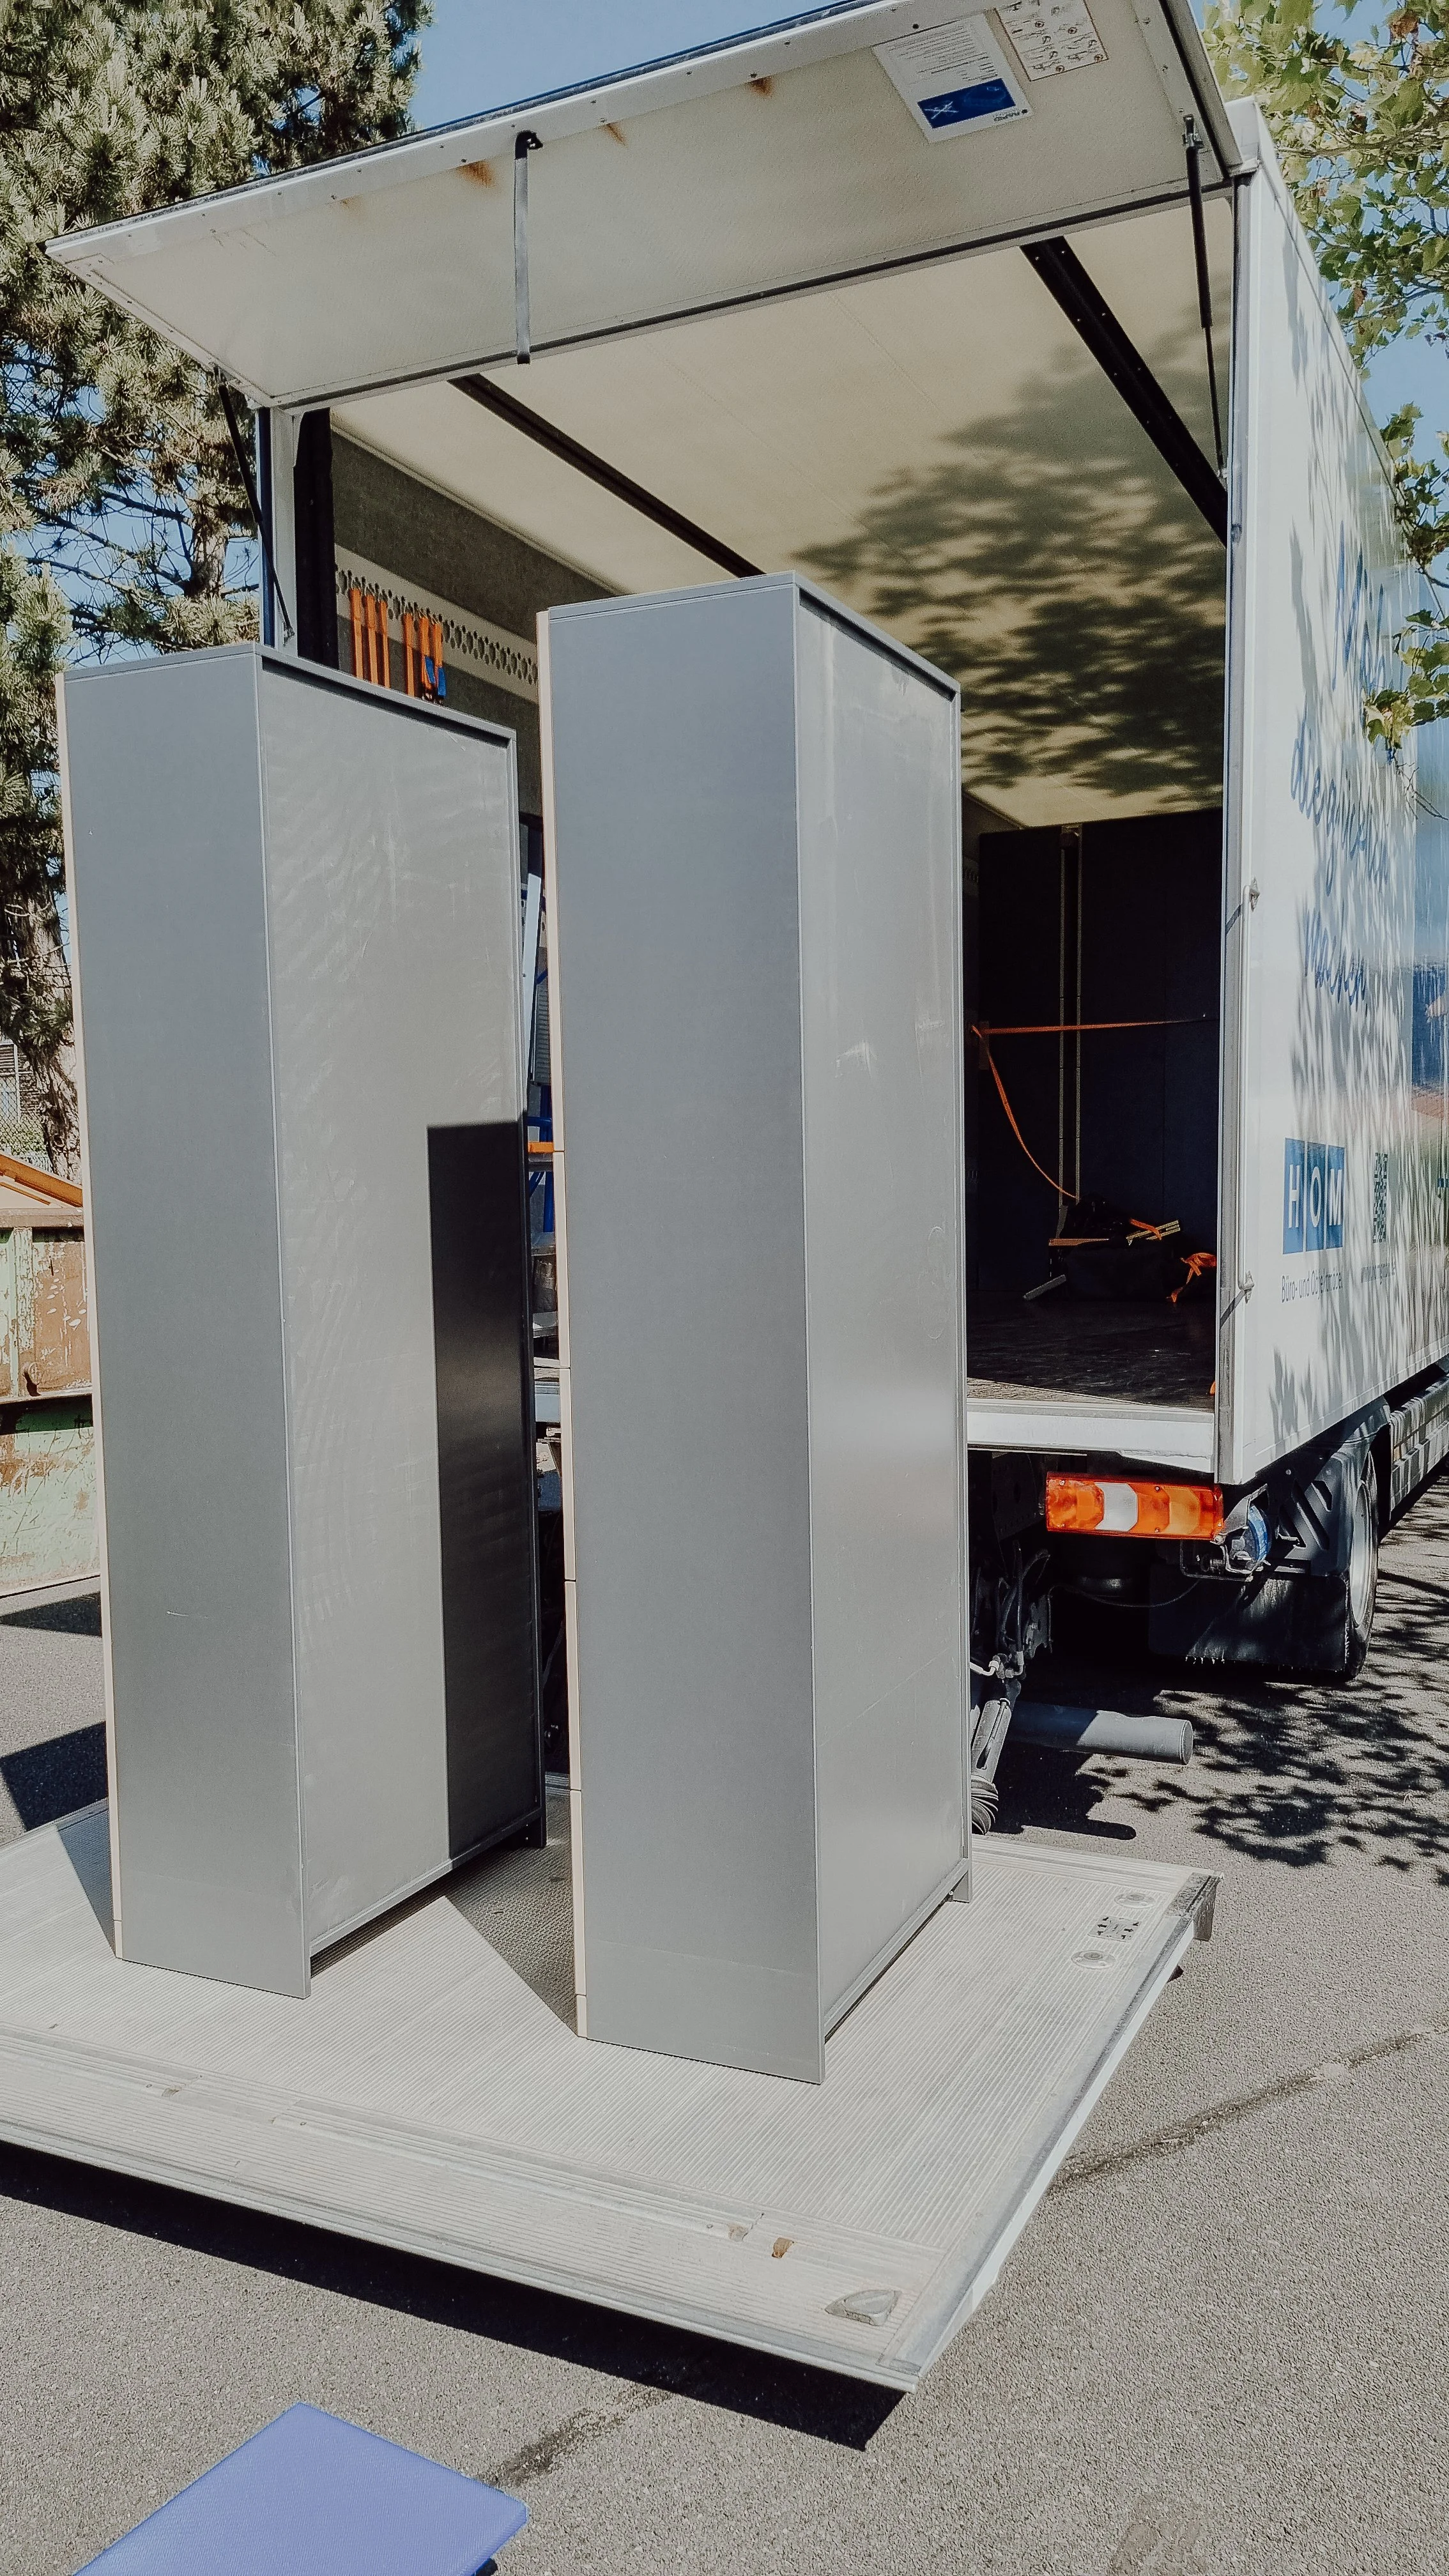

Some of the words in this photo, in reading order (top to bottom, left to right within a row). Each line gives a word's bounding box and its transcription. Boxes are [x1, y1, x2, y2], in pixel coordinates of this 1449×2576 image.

[1288, 1164, 1342, 1229] HOM
[1281, 1275, 1298, 1303] Büro-
[1299, 1271, 1310, 1299] und
